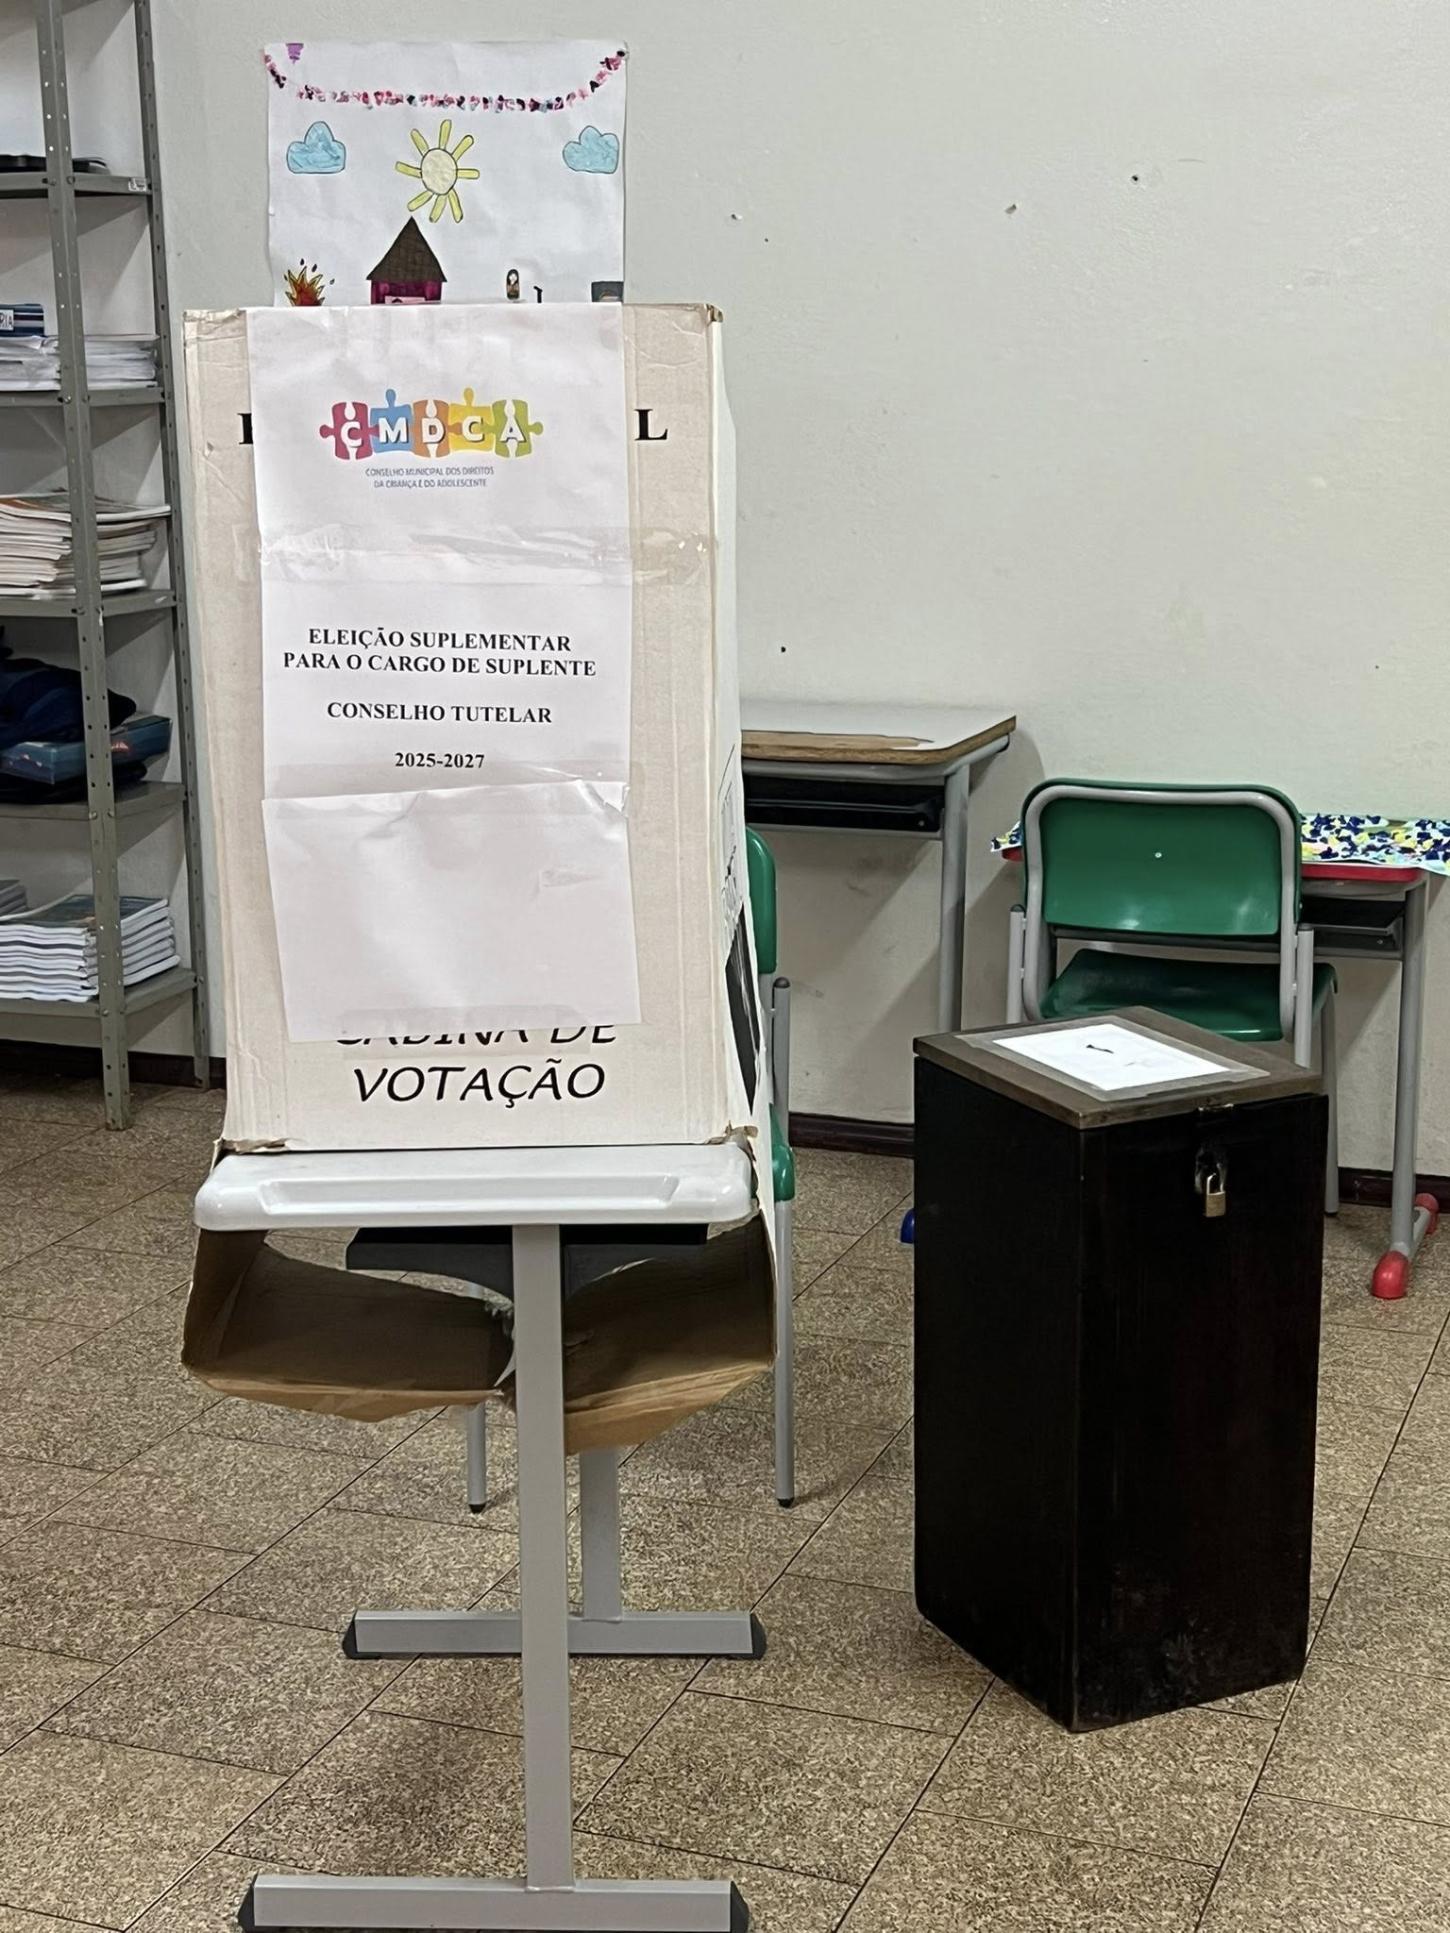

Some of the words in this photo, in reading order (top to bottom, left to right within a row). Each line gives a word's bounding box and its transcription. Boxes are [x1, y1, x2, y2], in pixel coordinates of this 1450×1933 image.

[340, 414, 526, 448] CMDCA
[365, 467, 404, 477] CONSELHO
[405, 467, 443, 476] MUNICIPAL
[445, 466, 461, 475] DOS
[462, 466, 495, 475] DIREITOS
[373, 480, 384, 488] DA
[385, 480, 417, 489] CRIANÇA
[424, 479, 436, 488] DO
[437, 478, 487, 488] ADOLESCENTE
[309, 626, 405, 649] ELEIÇÃO
[410, 631, 571, 652] SUPLEMENTAR
[283, 652, 341, 669] PARA
[346, 654, 362, 670] O
[367, 655, 446, 673] CARGO
[451, 657, 480, 674] DE
[485, 658, 597, 676] SUPLENTE
[327, 701, 445, 721] CONSELHO
[450, 705, 552, 723] TUTELAR
[395, 752, 485, 769] 2025-2027
[353, 1057, 605, 1109] VOTAÇÃO
